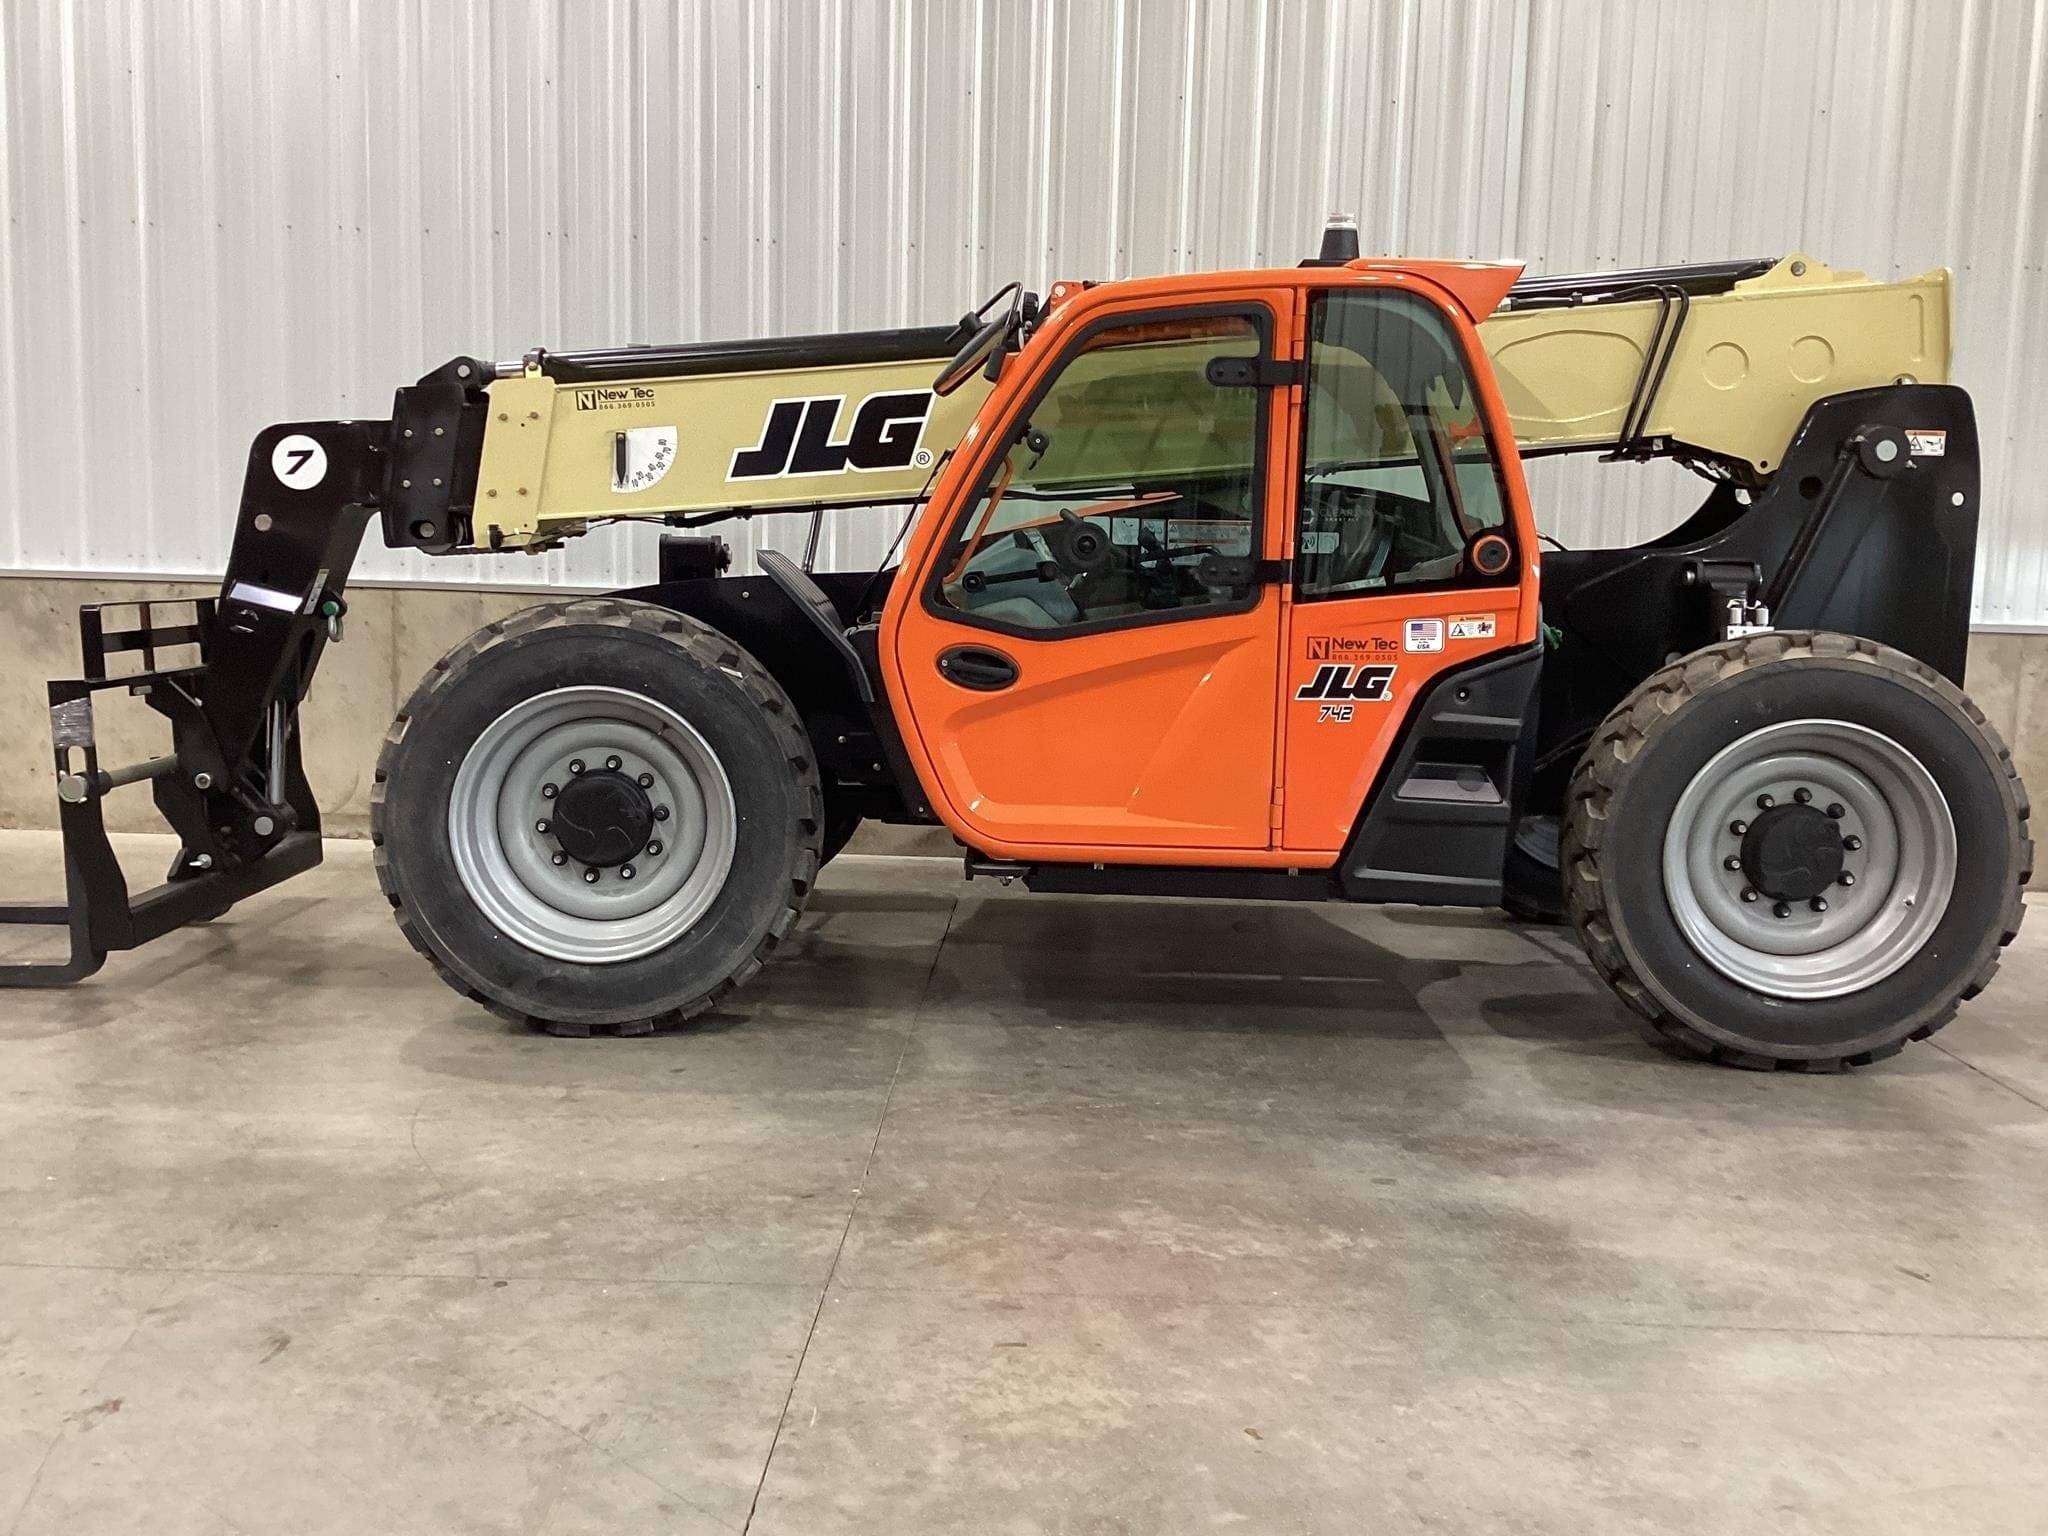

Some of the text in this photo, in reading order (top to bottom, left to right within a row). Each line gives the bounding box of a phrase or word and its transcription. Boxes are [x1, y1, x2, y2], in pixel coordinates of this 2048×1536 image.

[598, 389, 628, 401] New
[630, 387, 655, 399] Tec
[285, 449, 314, 475] 7
[1332, 637, 1368, 650] New
[1371, 637, 1398, 650] Tec
[1318, 705, 1354, 722] 742
